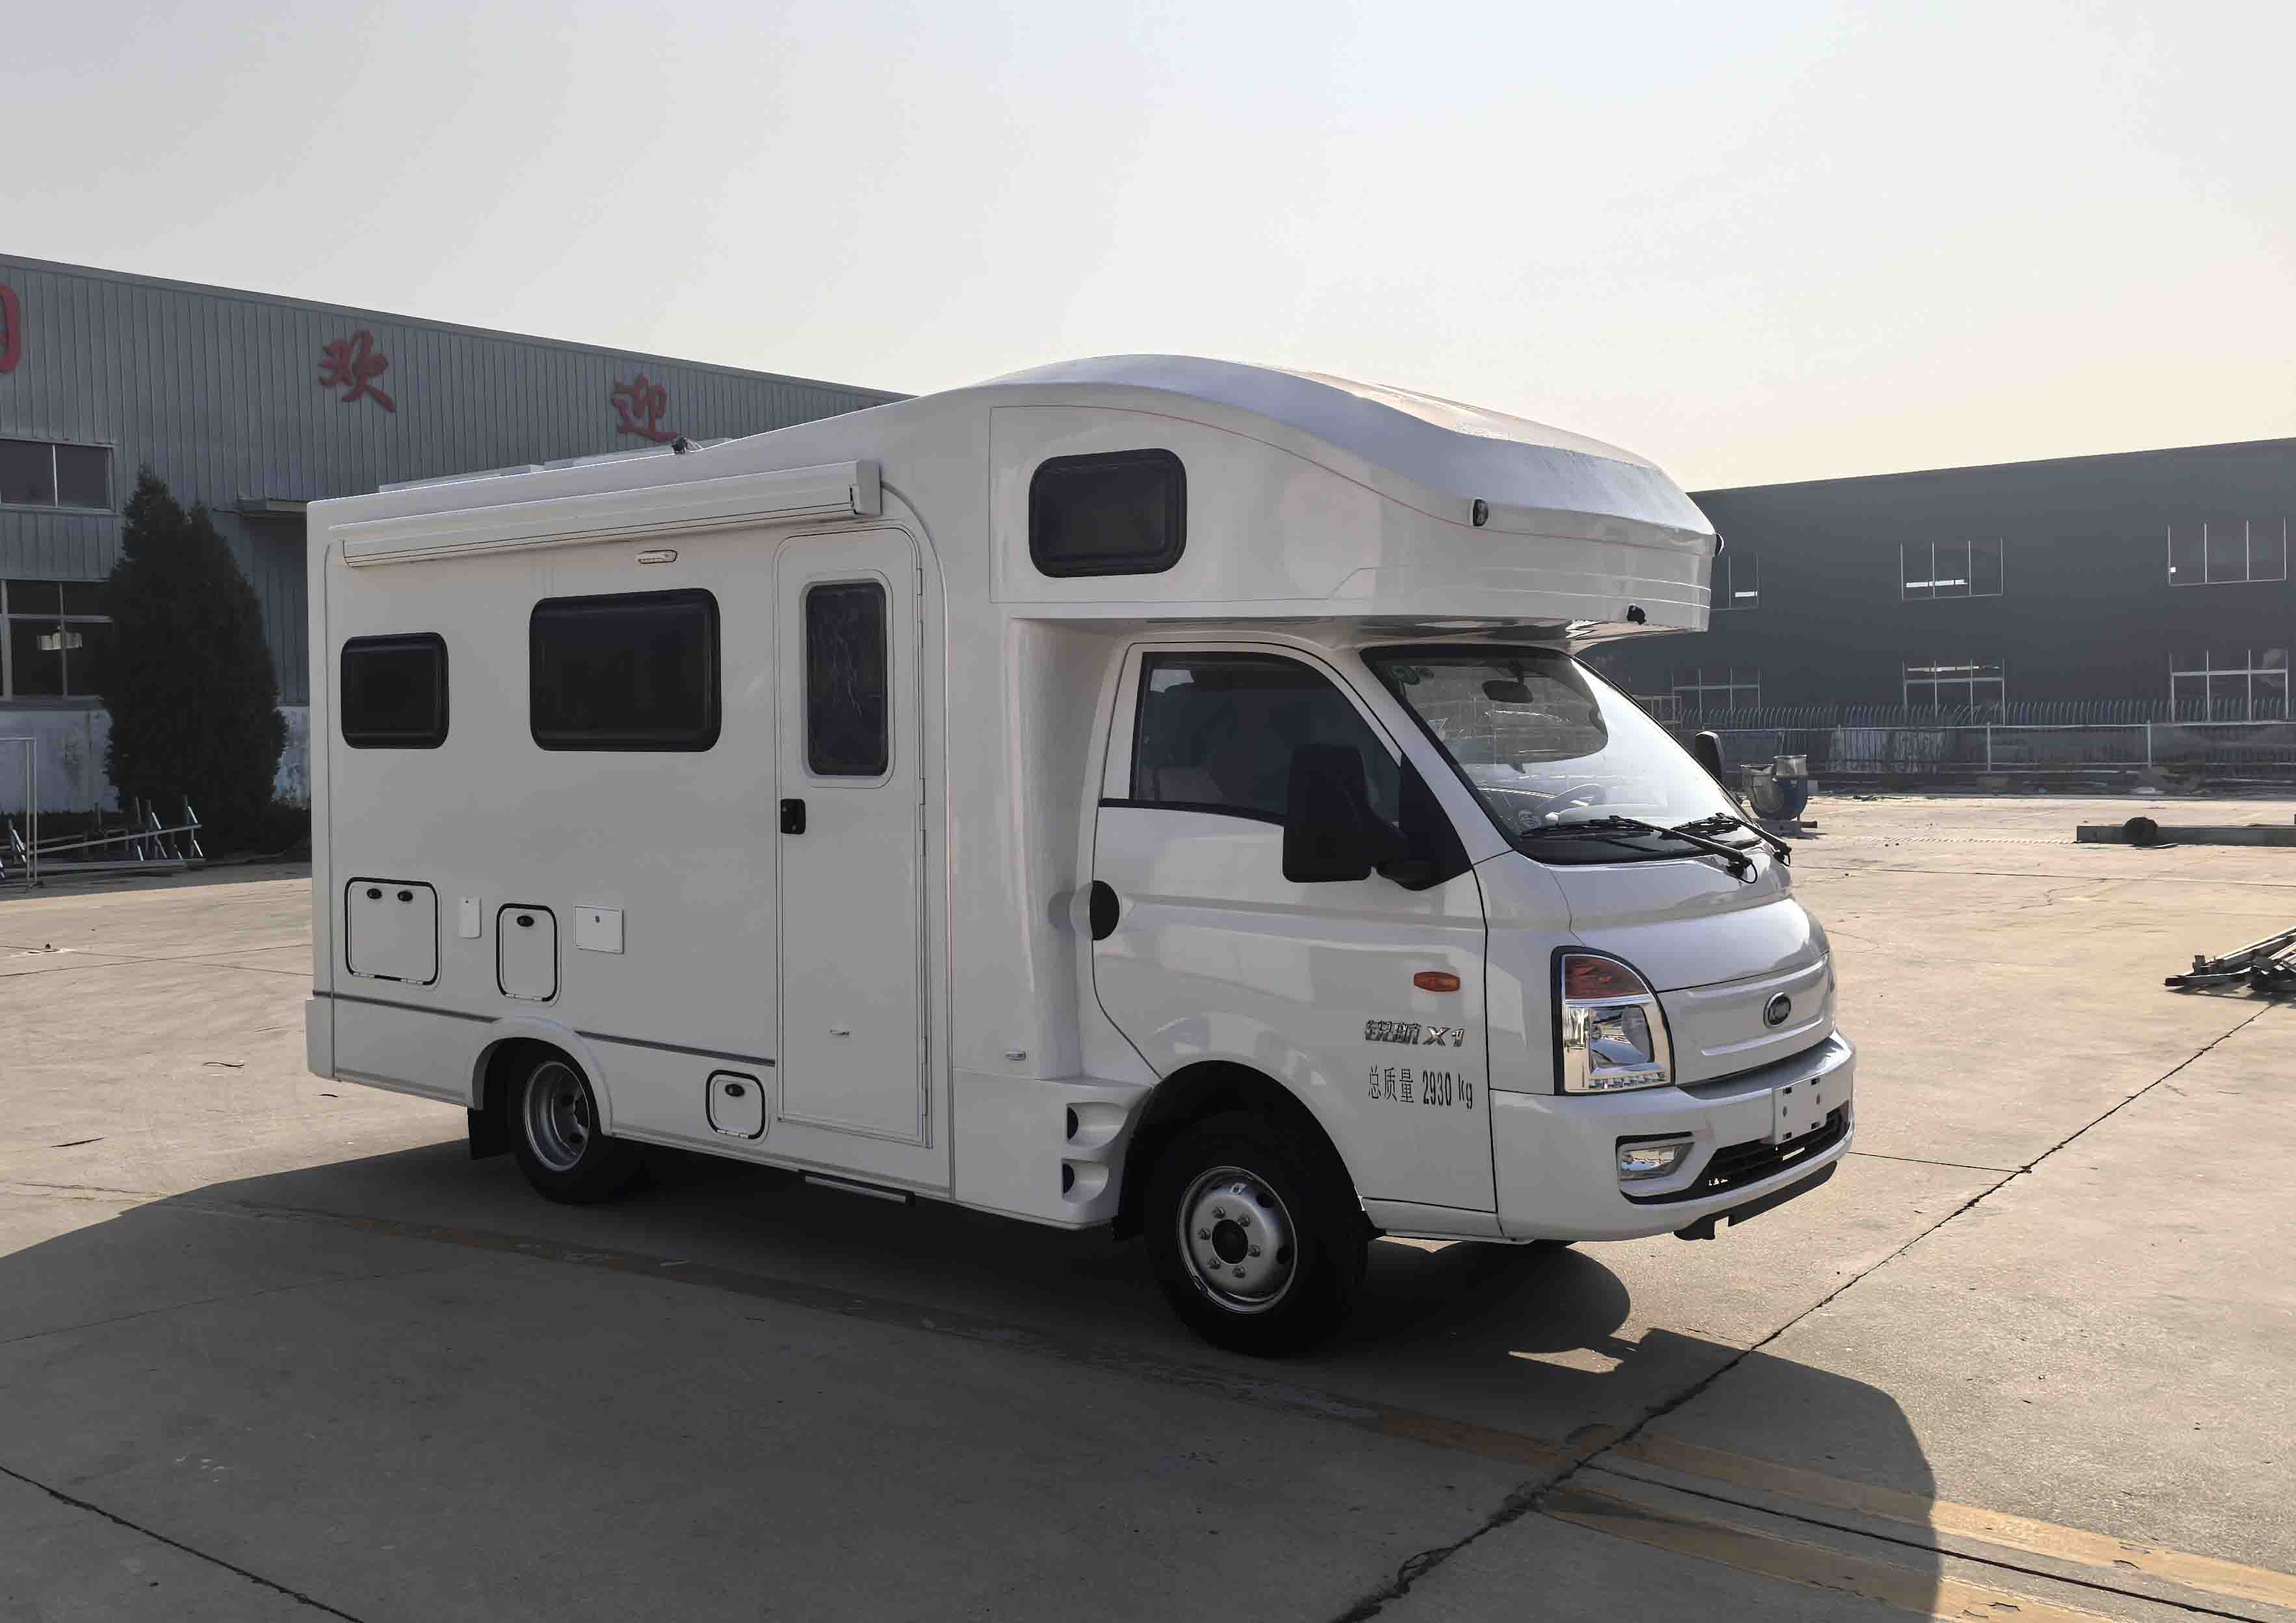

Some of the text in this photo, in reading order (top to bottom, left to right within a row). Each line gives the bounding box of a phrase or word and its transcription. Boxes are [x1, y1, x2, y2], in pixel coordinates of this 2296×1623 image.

[1422, 1025, 1465, 1048] X1
[1368, 1066, 1474, 1110] 总质量 2930 kg
